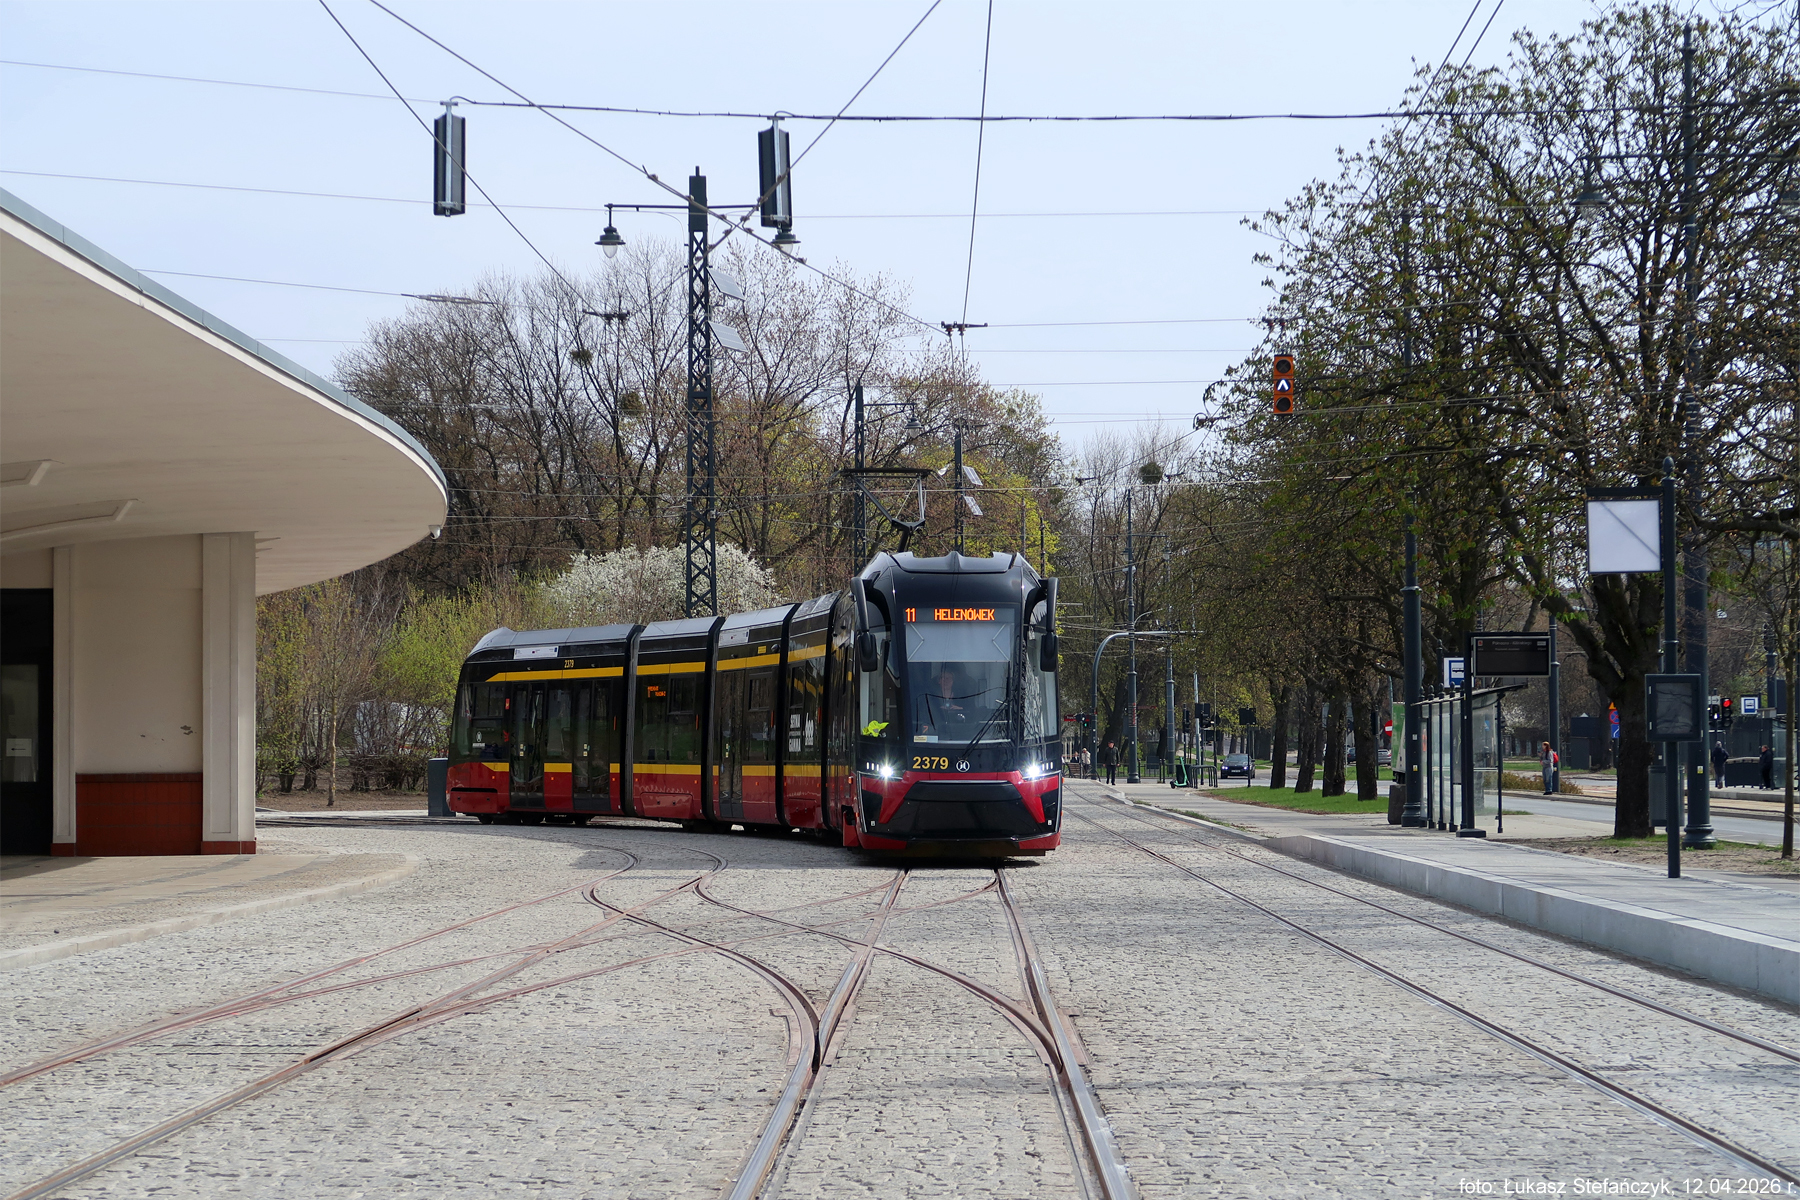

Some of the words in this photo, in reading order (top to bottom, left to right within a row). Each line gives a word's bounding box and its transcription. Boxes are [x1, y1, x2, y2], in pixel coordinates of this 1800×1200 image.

[905, 607, 916, 622] 11
[934, 608, 995, 621] HELENÓWEK
[564, 660, 574, 668] 2379
[912, 756, 949, 770] 2379
